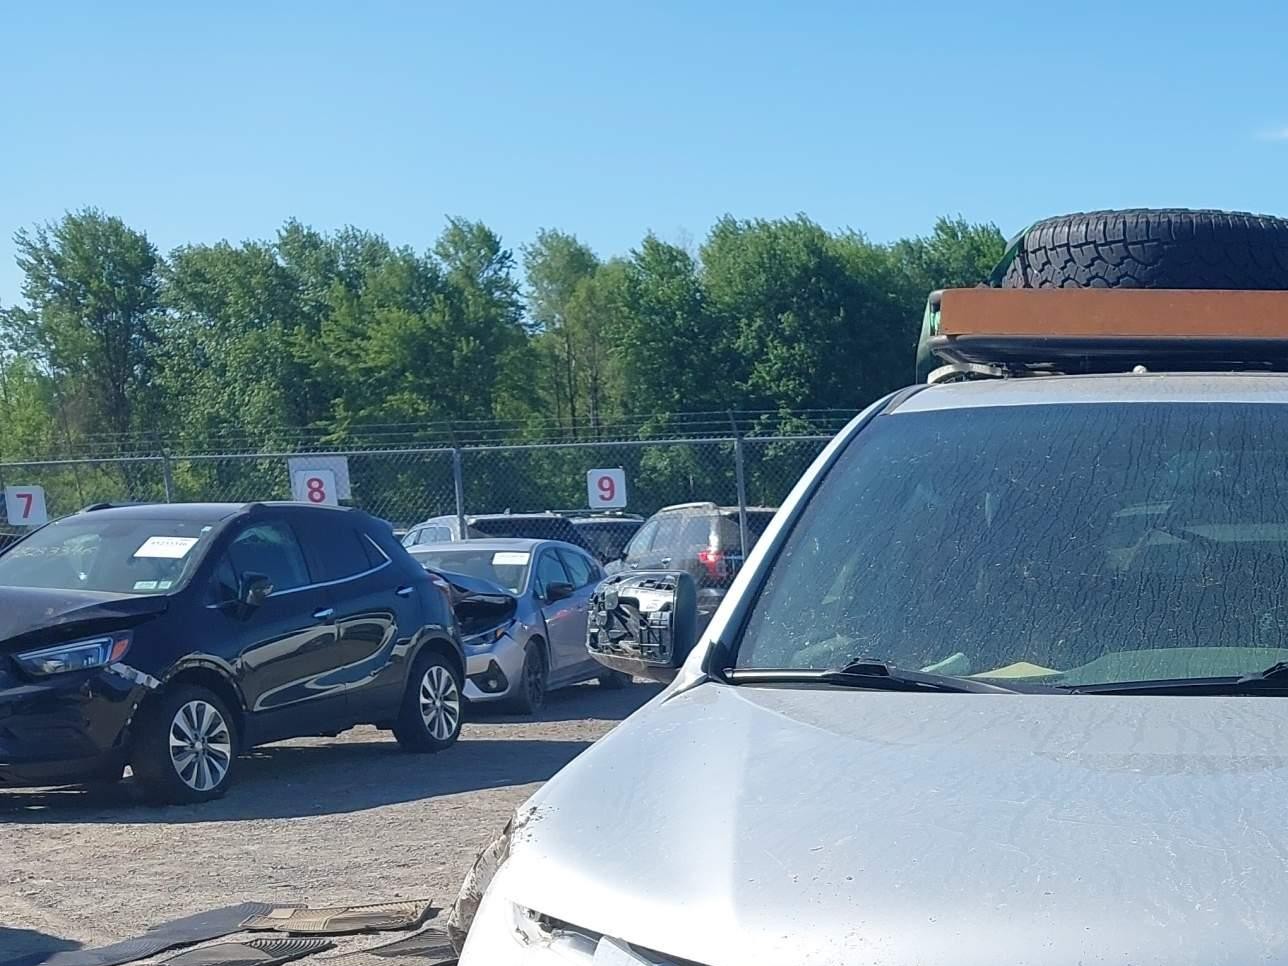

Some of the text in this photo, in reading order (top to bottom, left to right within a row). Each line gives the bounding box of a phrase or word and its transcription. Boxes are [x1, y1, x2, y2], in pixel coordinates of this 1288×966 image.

[306, 477, 326, 503] 8
[597, 475, 616, 502] 9
[15, 493, 33, 519] 7
